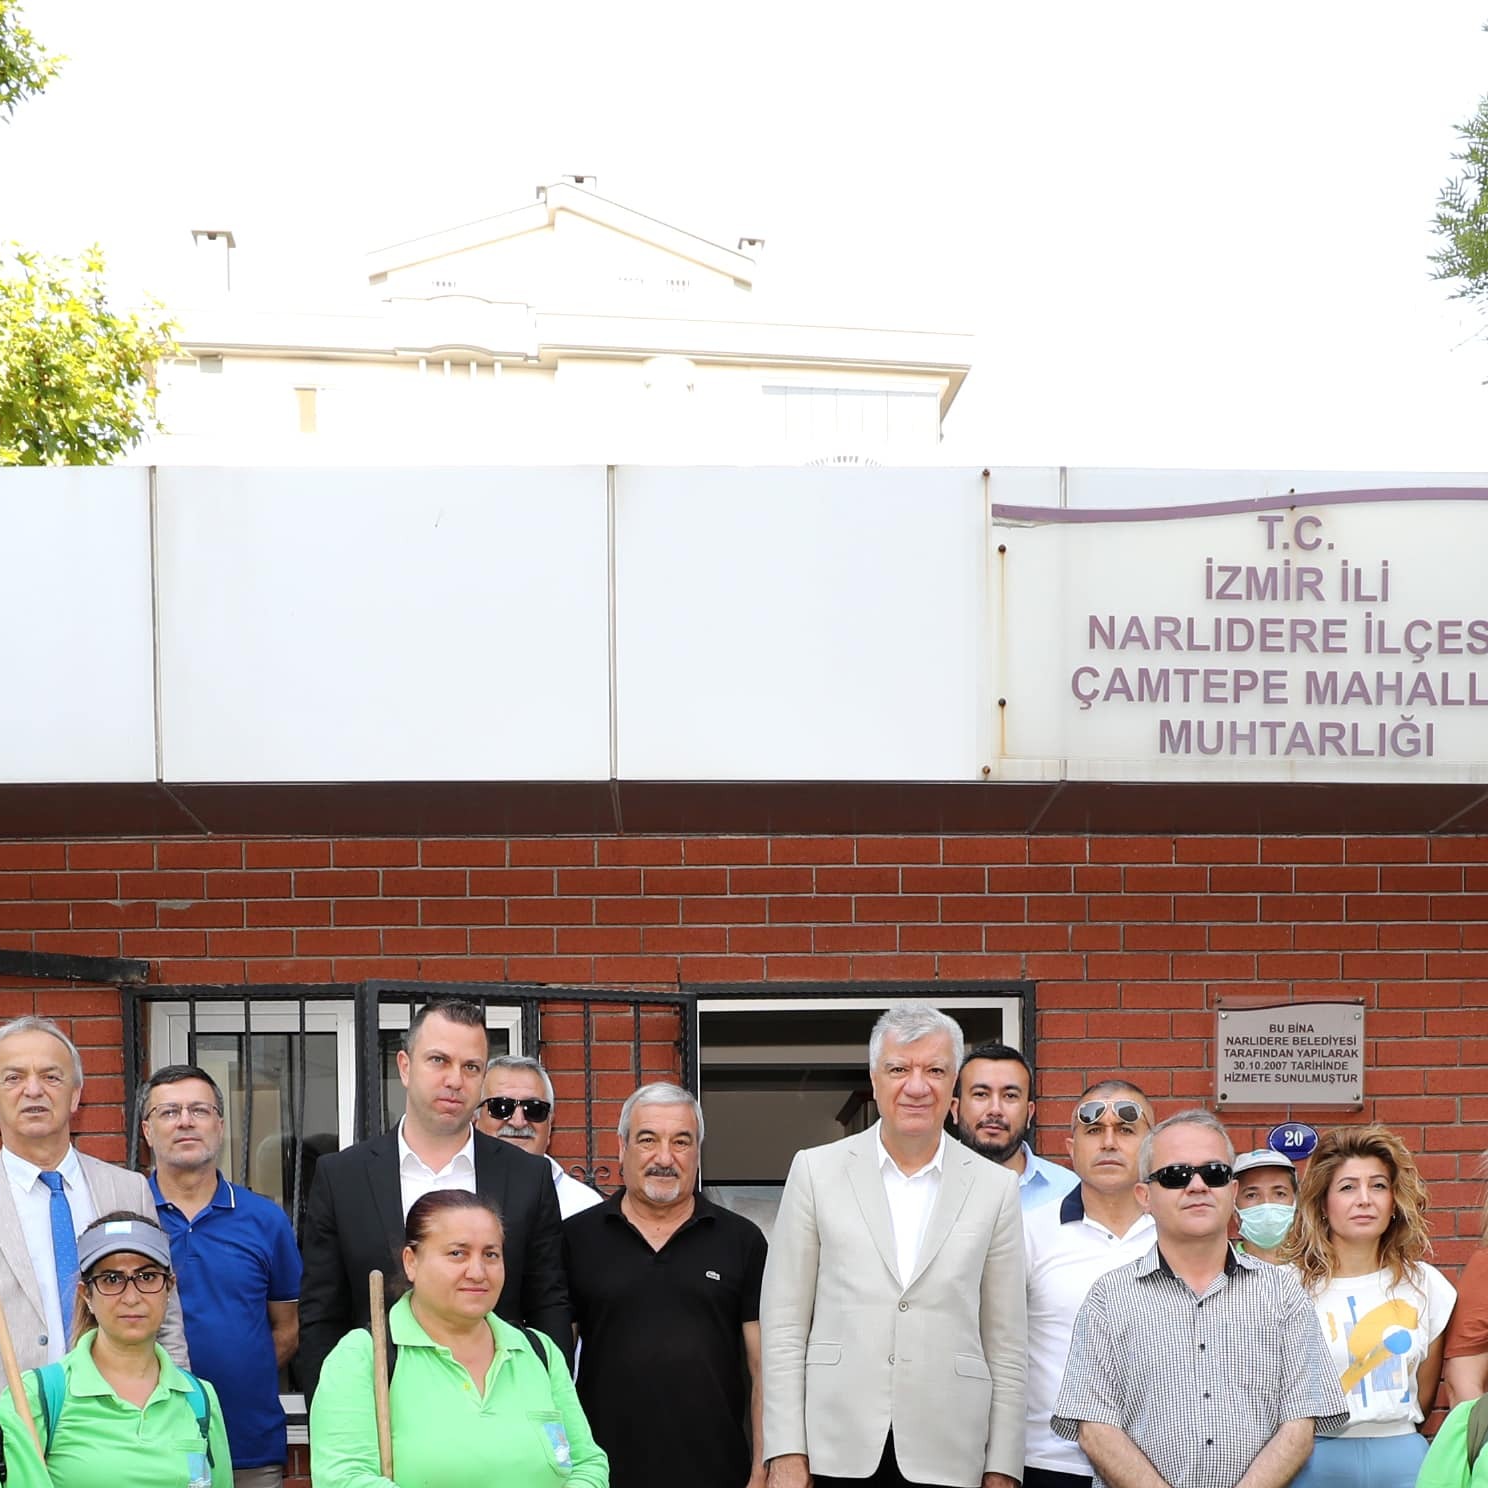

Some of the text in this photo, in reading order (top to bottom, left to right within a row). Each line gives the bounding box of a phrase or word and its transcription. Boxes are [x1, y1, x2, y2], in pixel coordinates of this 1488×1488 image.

[1258, 515, 1335, 551] T.C.
[1205, 557, 1389, 603] İZMİR İLİ
[1088, 615, 1348, 654] NARLIDERE
[1071, 666, 1289, 710] ÇAMTEPE
[1159, 714, 1434, 758] MUHTARLIĞI
[1269, 1021, 1314, 1034] BU BİNA
[1226, 1034, 1357, 1046] NARLIDERE BELEDİYESİ
[1224, 1048, 1359, 1059] TARAFINDAN YAPILARAK
[1233, 1059, 1349, 1071] 30.10.2007 TARİHİNDE
[1224, 1071, 1358, 1085] HİZMETE SUNULMUŞTUR
[1284, 1130, 1304, 1147] 20
